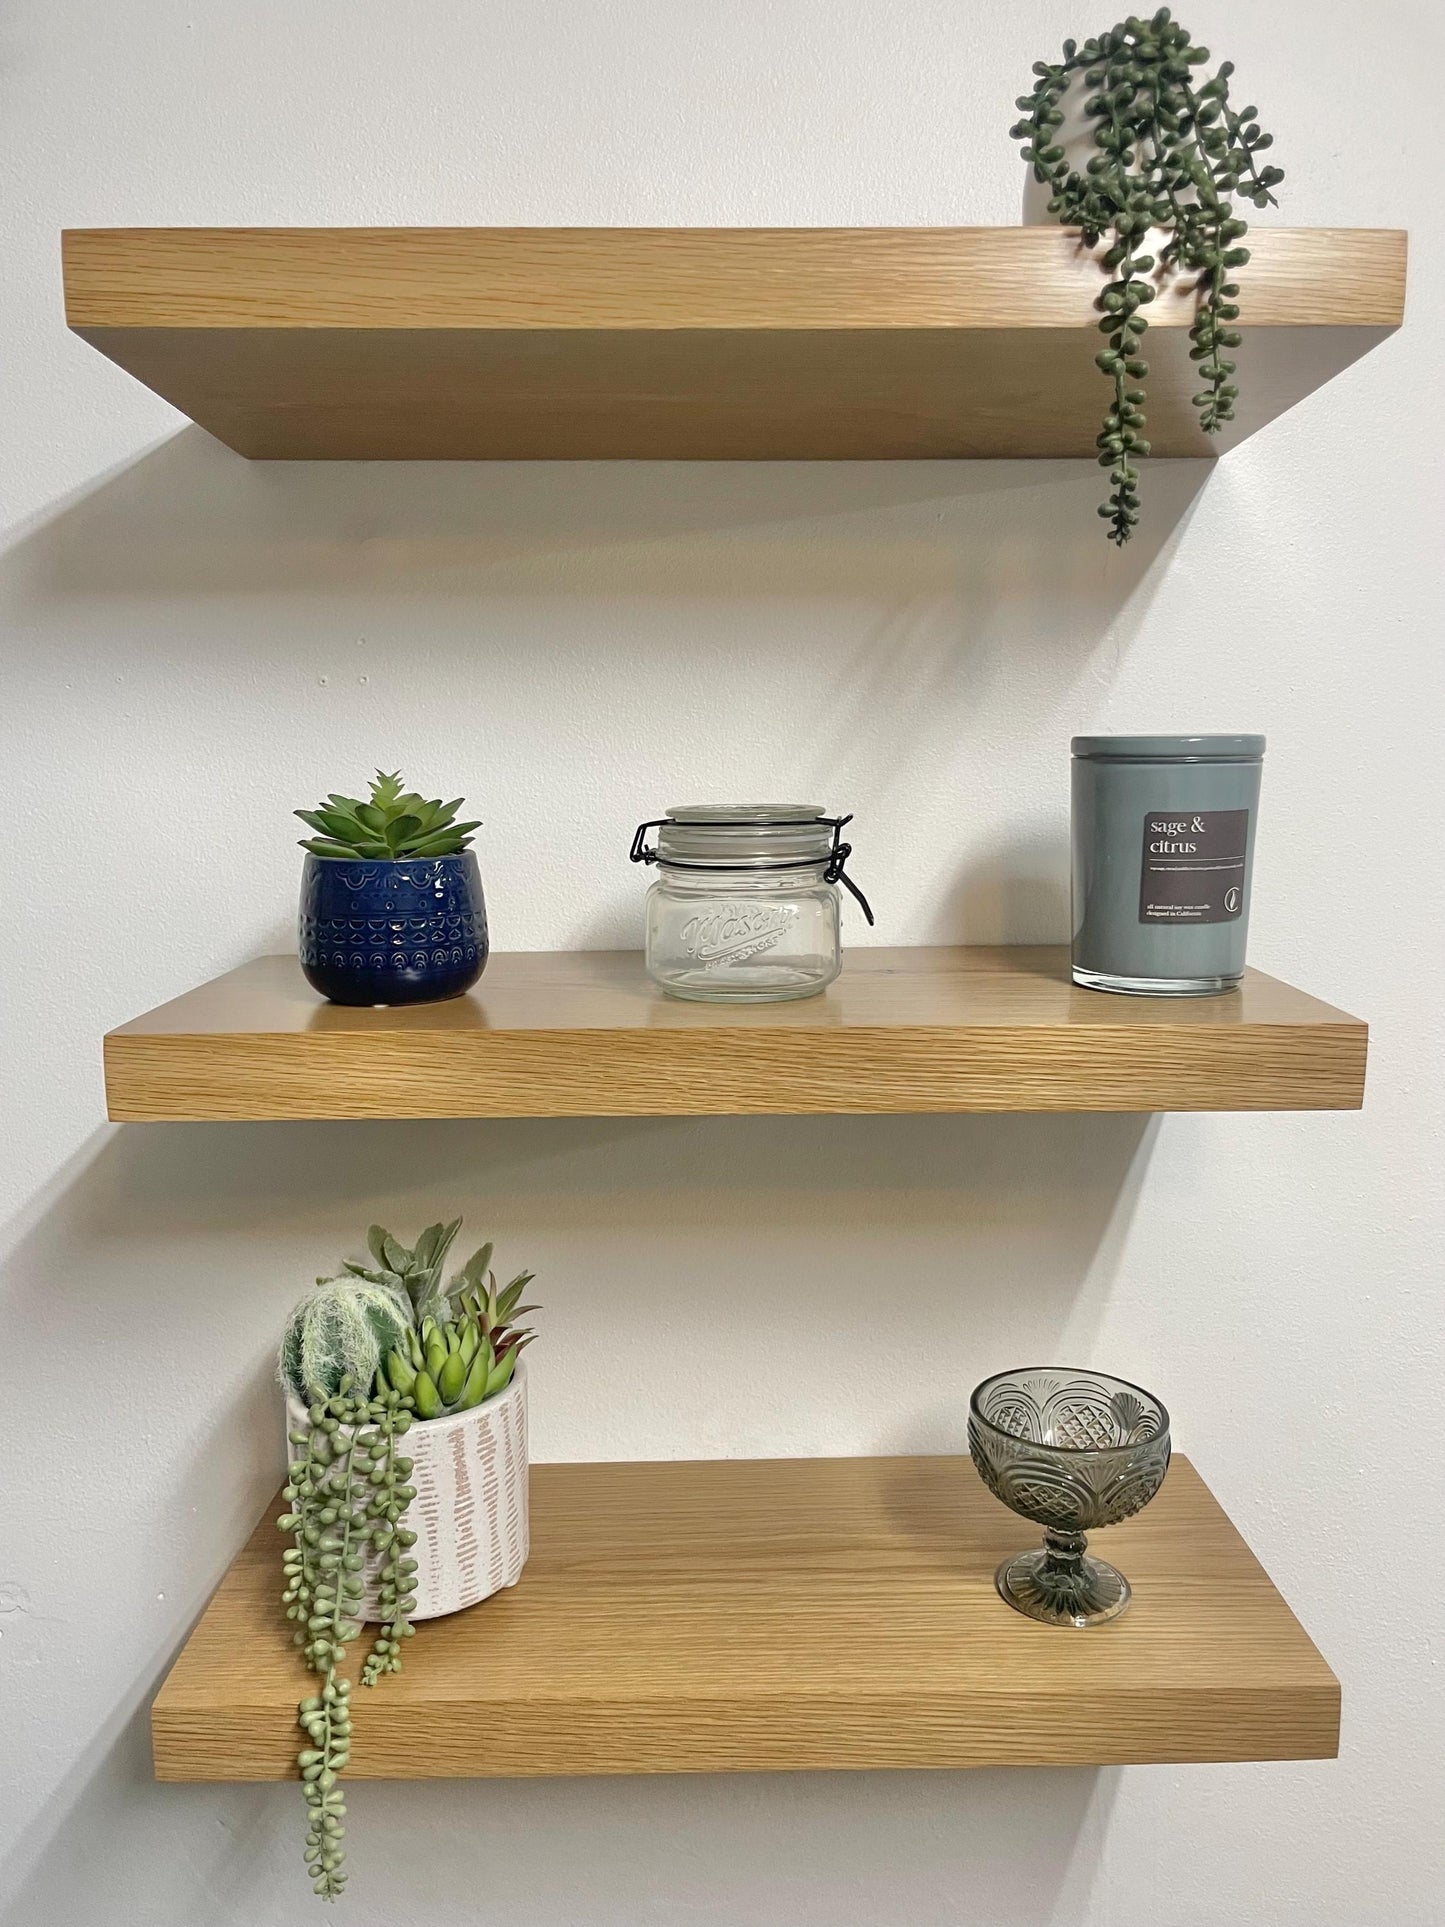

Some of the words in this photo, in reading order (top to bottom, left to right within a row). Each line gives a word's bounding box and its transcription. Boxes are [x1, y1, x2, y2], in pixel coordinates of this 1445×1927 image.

[1150, 821, 1187, 836] sage
[1191, 816, 1206, 832] &
[1150, 840, 1197, 853] citrus
